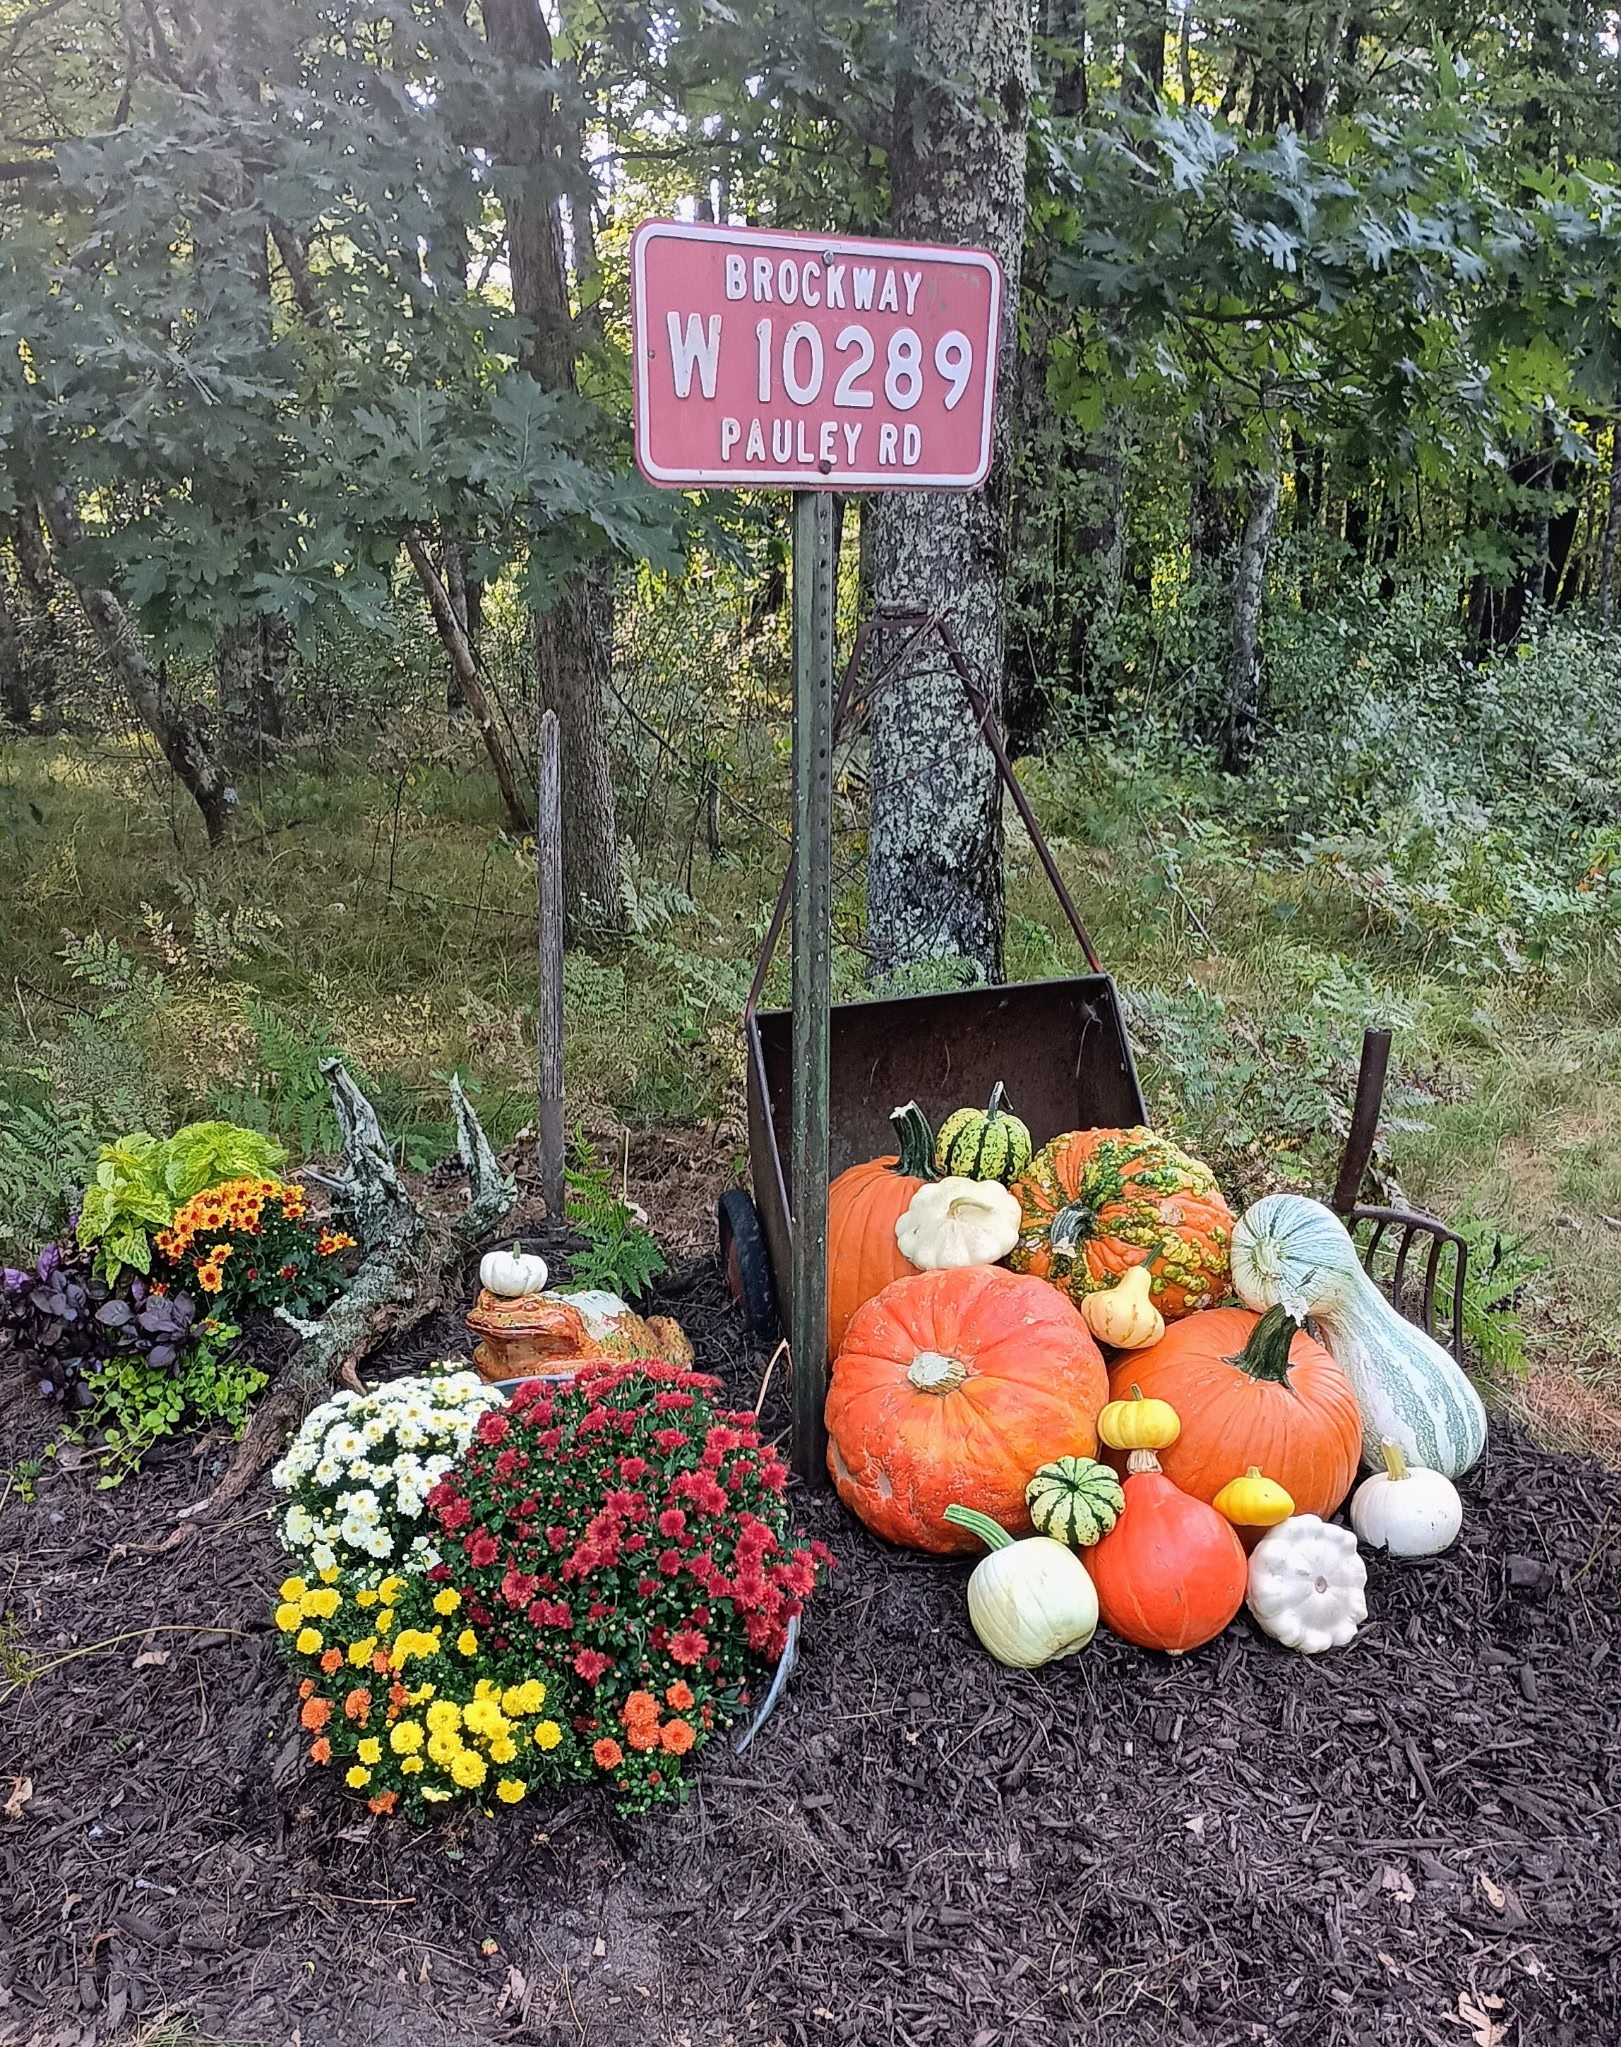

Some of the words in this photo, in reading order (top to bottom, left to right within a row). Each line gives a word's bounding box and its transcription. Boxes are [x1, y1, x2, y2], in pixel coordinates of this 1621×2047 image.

[725, 254, 922, 315] BROCKWAY
[666, 311, 722, 399] W
[756, 318, 973, 411] 10289
[720, 417, 863, 466] PAULEY
[878, 422, 922, 466] RD
